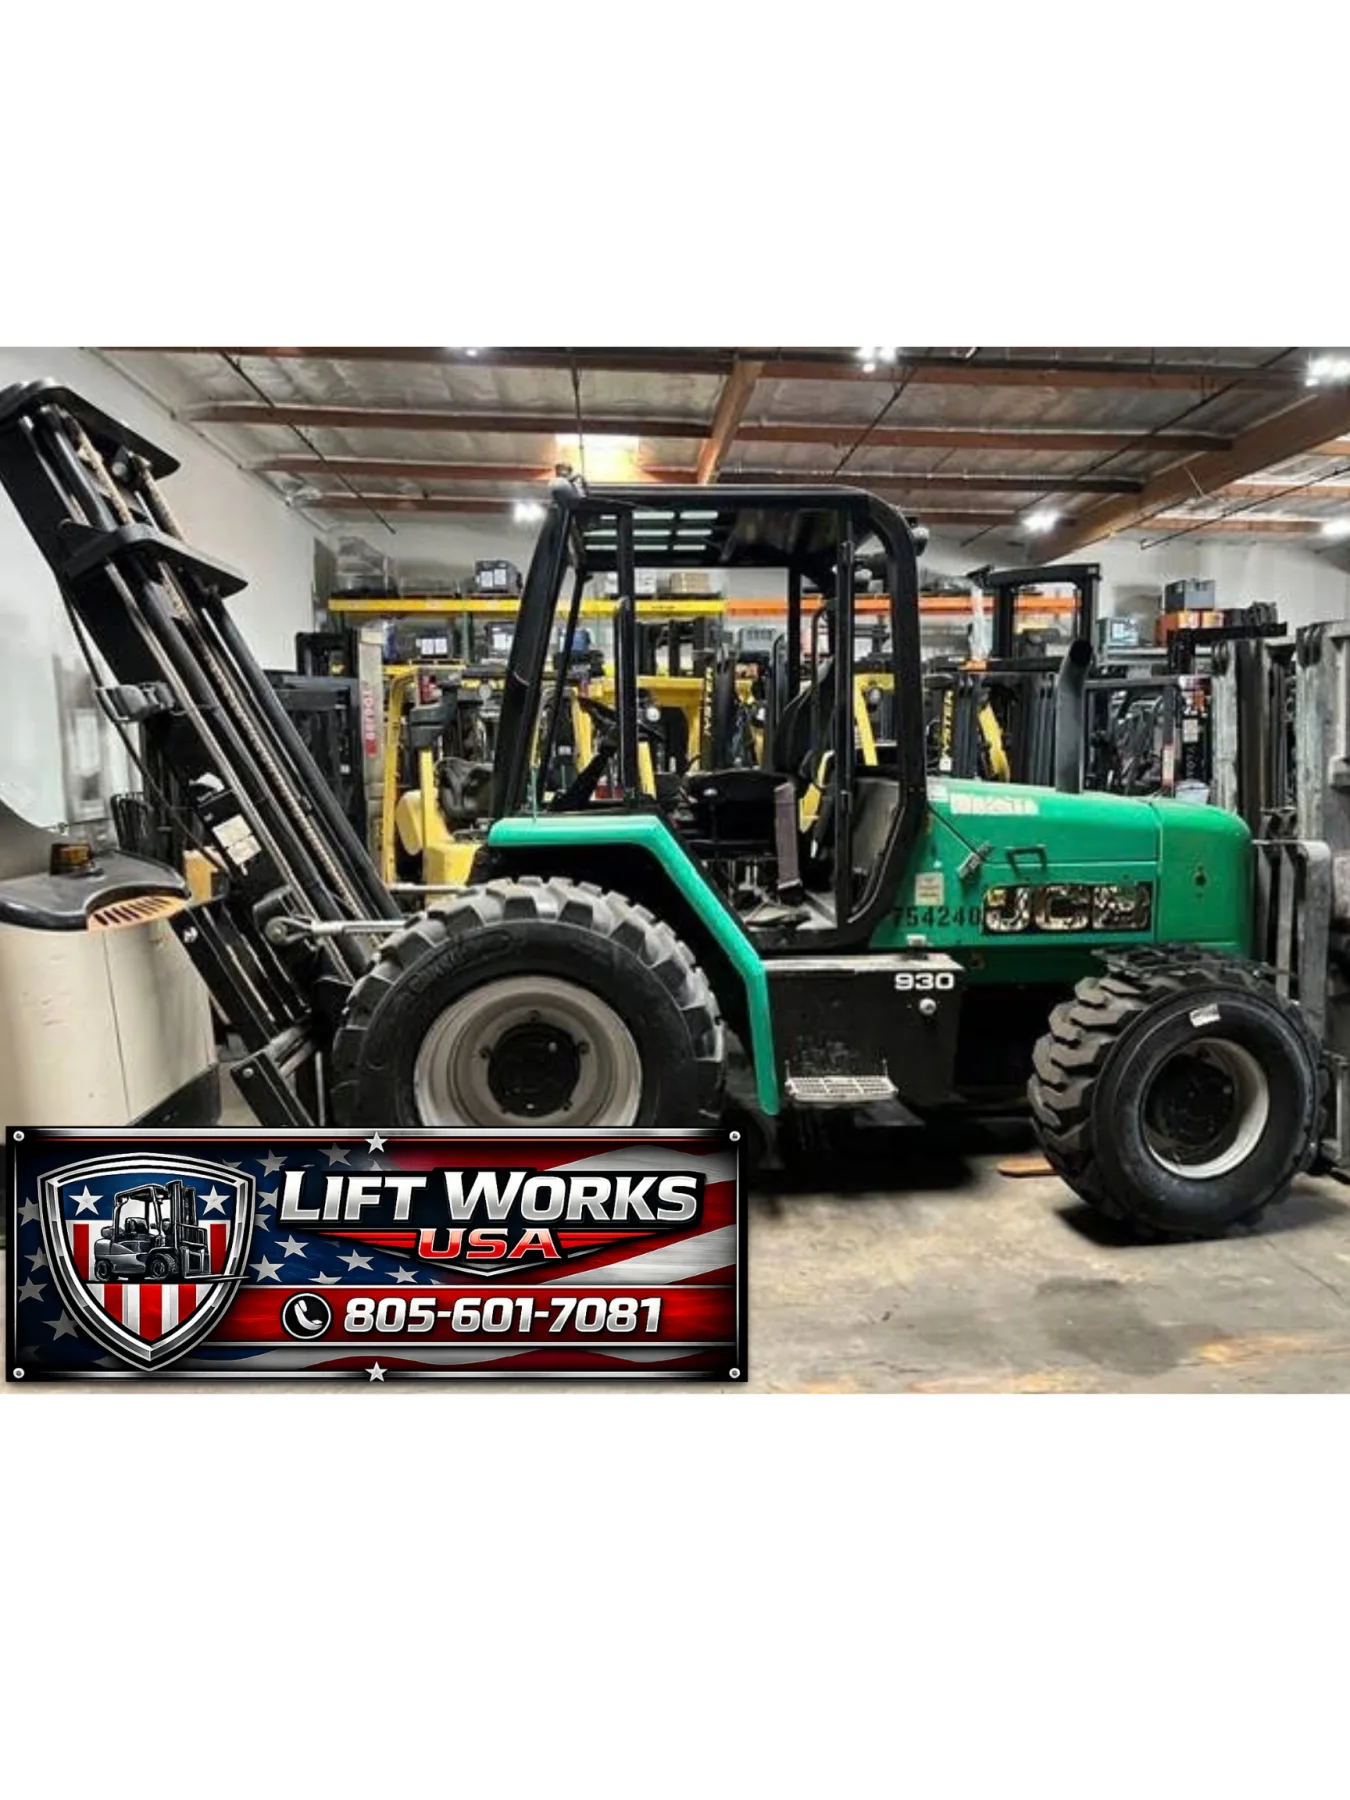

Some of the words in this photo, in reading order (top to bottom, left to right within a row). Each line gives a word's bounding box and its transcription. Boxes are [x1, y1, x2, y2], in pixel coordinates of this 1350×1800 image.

[941, 690, 954, 759] YSTER
[893, 906, 981, 927] 754240
[894, 972, 955, 991] 930
